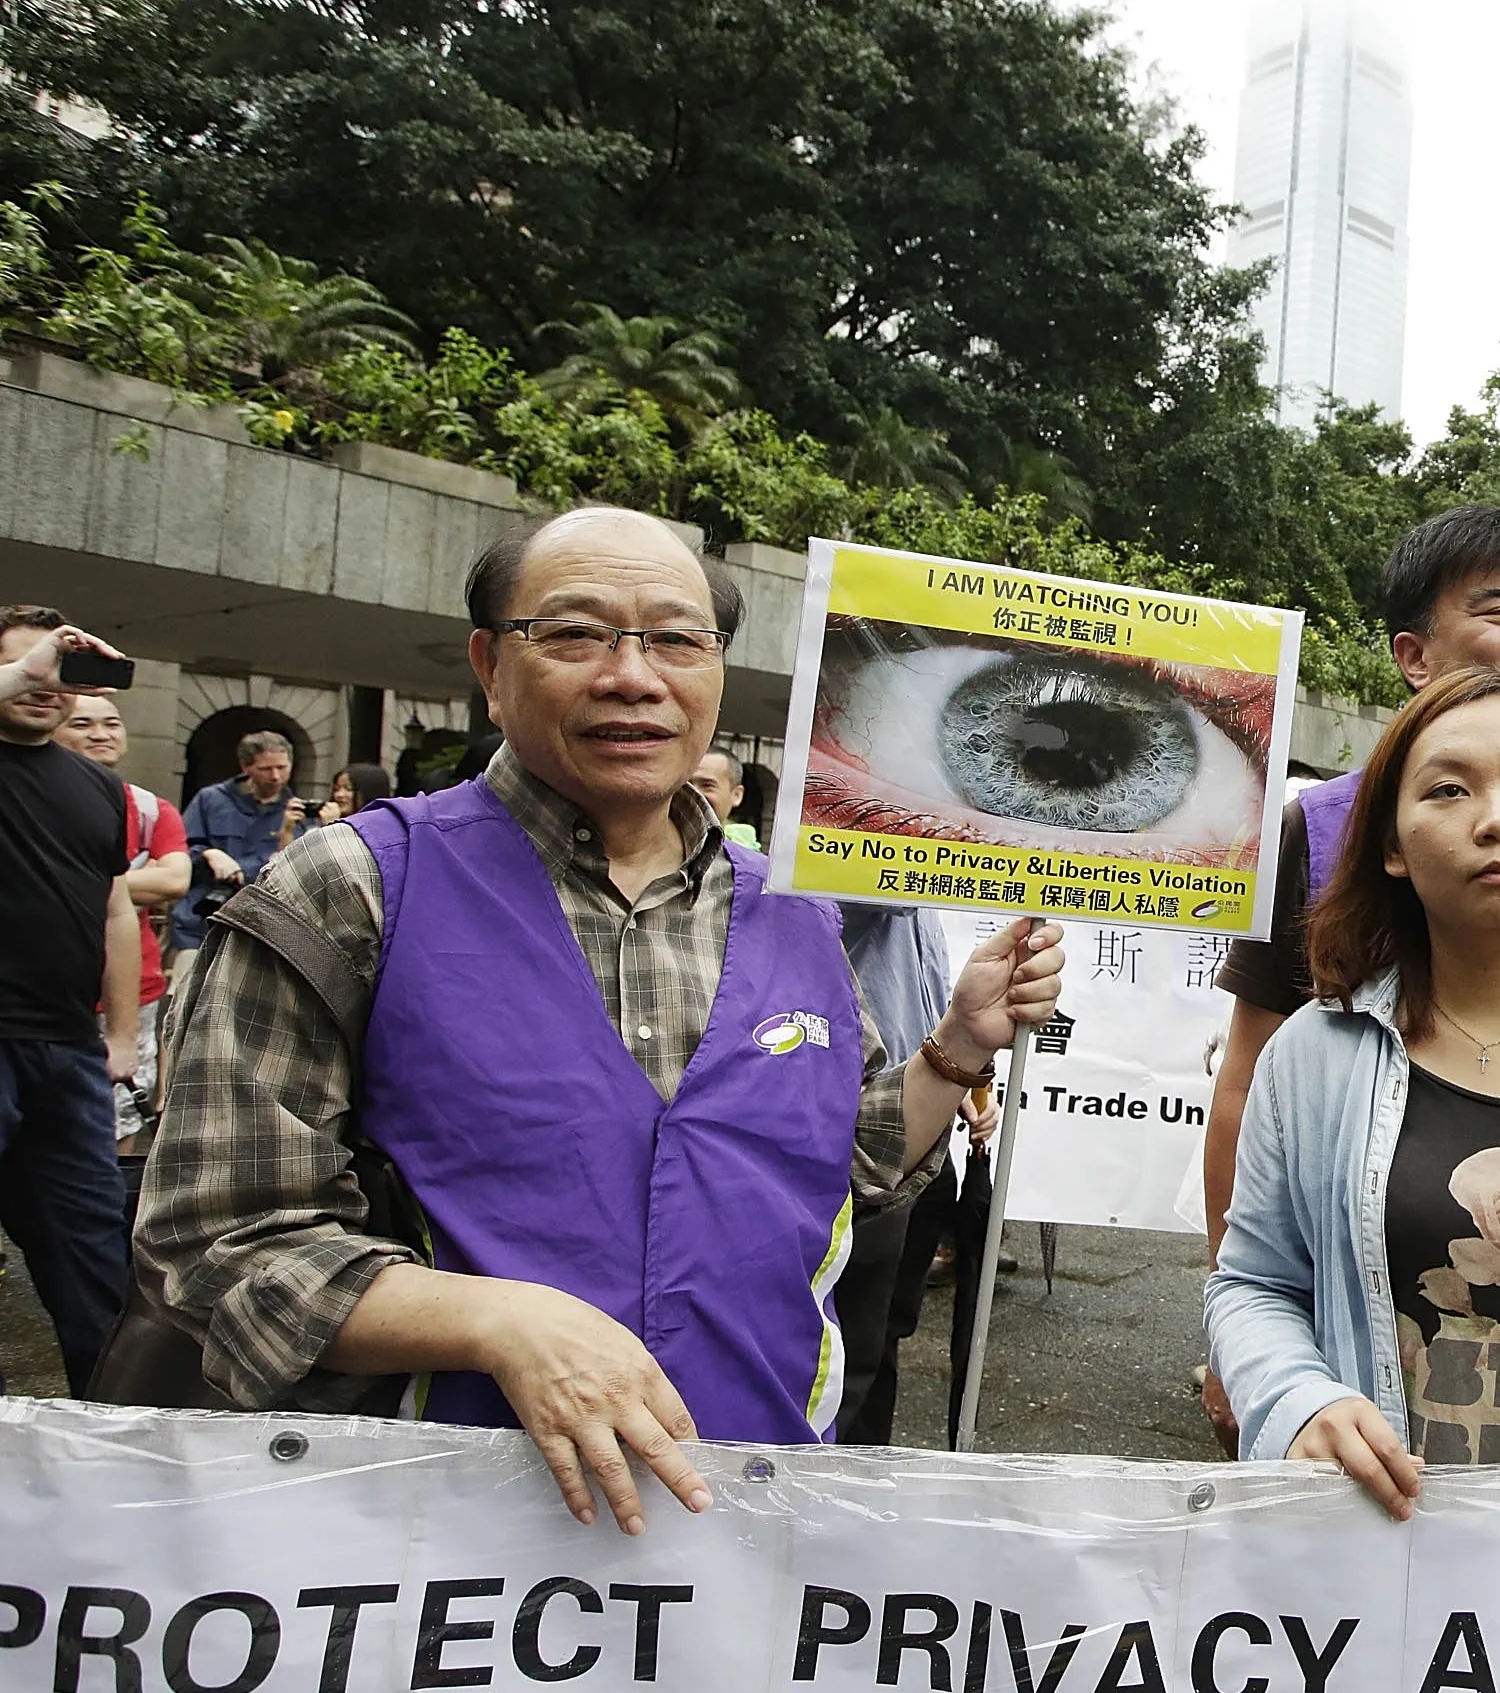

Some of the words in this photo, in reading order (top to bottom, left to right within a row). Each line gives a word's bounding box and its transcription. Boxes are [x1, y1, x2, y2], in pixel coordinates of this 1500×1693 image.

[927, 569, 934, 588] I
[941, 572, 984, 596] AM
[993, 579, 1131, 617] WATCHING
[1138, 601, 1198, 627] YOU!
[808, 833, 854, 860] Say
[861, 839, 896, 860] No
[903, 845, 928, 863] to
[935, 847, 1020, 877] Privacy
[1026, 856, 1141, 885] &Liberties
[1149, 869, 1246, 895] Violation
[877, 869, 1026, 904] 反對網絡監視
[1039, 884, 1179, 918] 保障個人私隱
[1043, 1086, 1148, 1120] Trade
[791, 1585, 1360, 1693] PRIVACY
